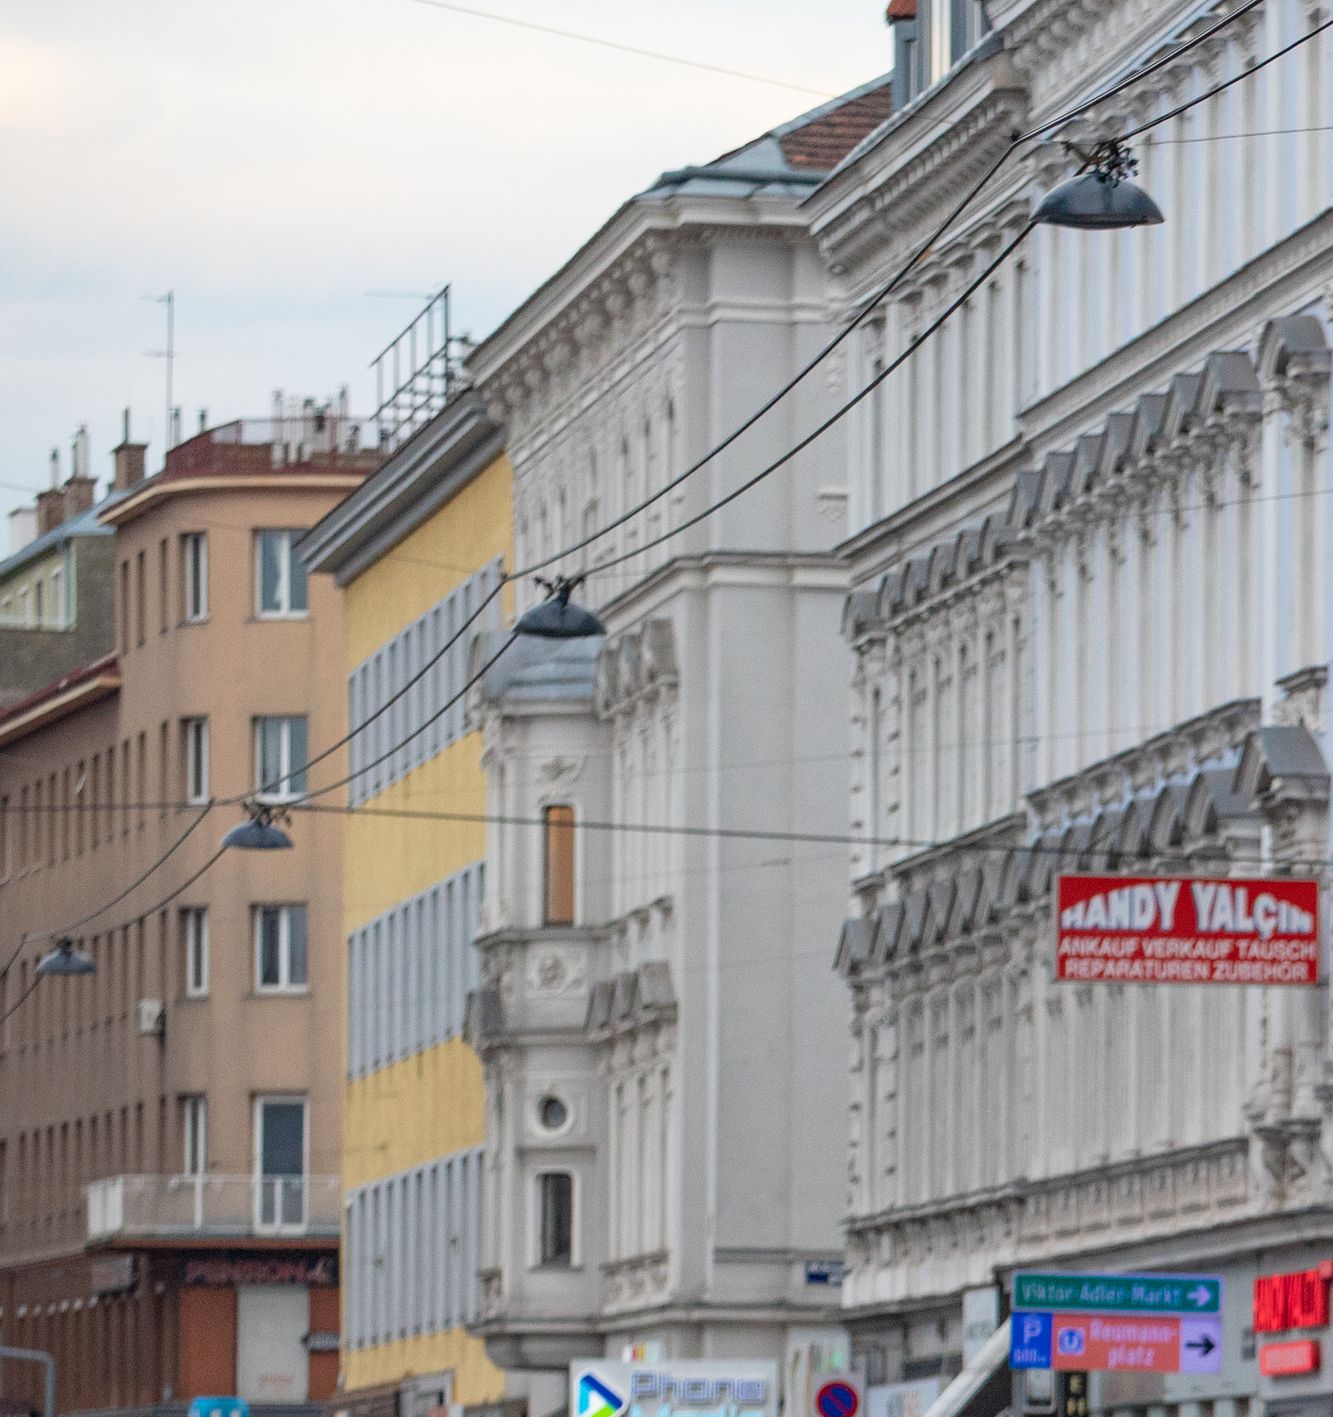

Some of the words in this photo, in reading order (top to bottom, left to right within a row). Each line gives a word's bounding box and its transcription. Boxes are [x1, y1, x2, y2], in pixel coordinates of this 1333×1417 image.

[1061, 881, 1181, 931] HANDY
[1058, 938, 1140, 957] ANKAUF
[1144, 939, 1233, 959] VERKAUF
[1239, 940, 1315, 960] TAUSCH
[1065, 958, 1209, 979] REPARATUREN
[1213, 962, 1308, 981] ZUBEHÖR
[1022, 1318, 1042, 1344] P
[1107, 1346, 1156, 1369] platz
[631, 1369, 764, 1402] Phone
